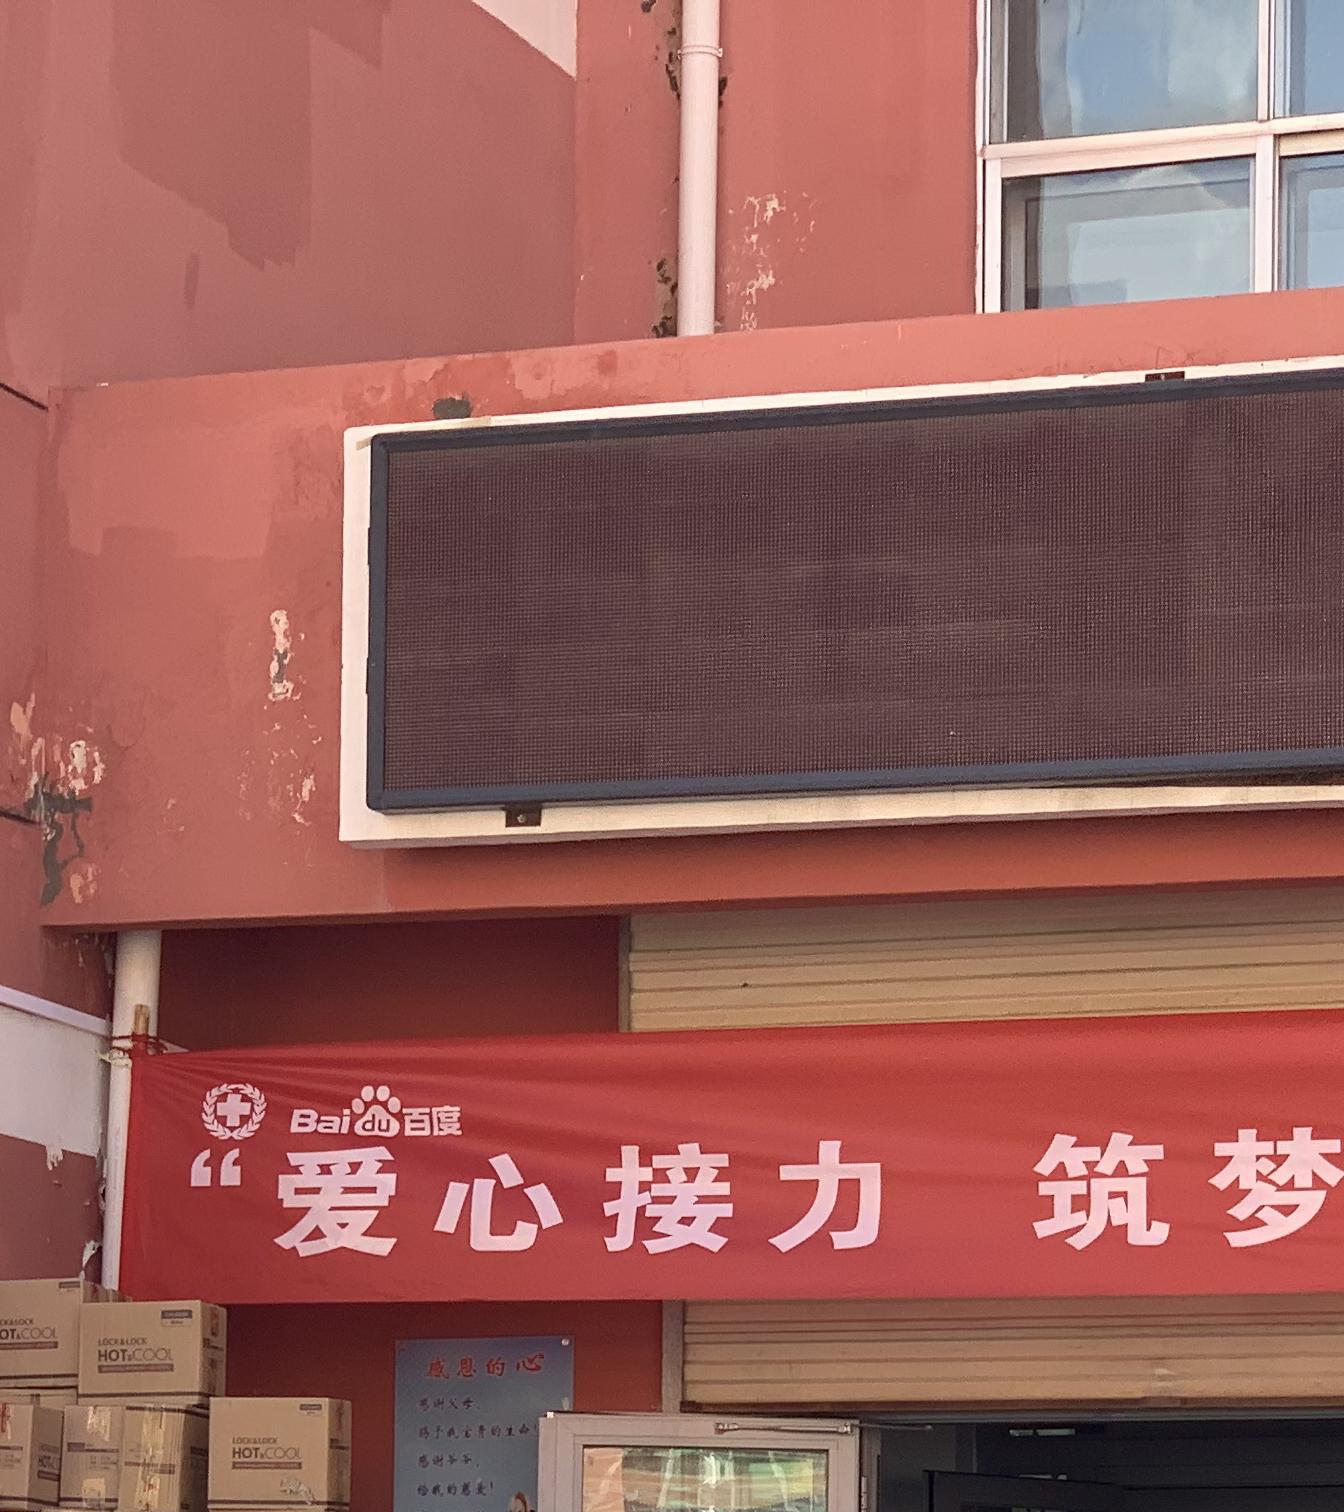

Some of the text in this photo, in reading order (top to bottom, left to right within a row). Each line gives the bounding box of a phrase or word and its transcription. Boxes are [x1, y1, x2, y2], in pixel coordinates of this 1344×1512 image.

[190, 1140, 882, 1257] “爱心接力
[98, 1348, 174, 1362] HOT&COOL
[426, 1352, 544, 1380] 感恩的心
